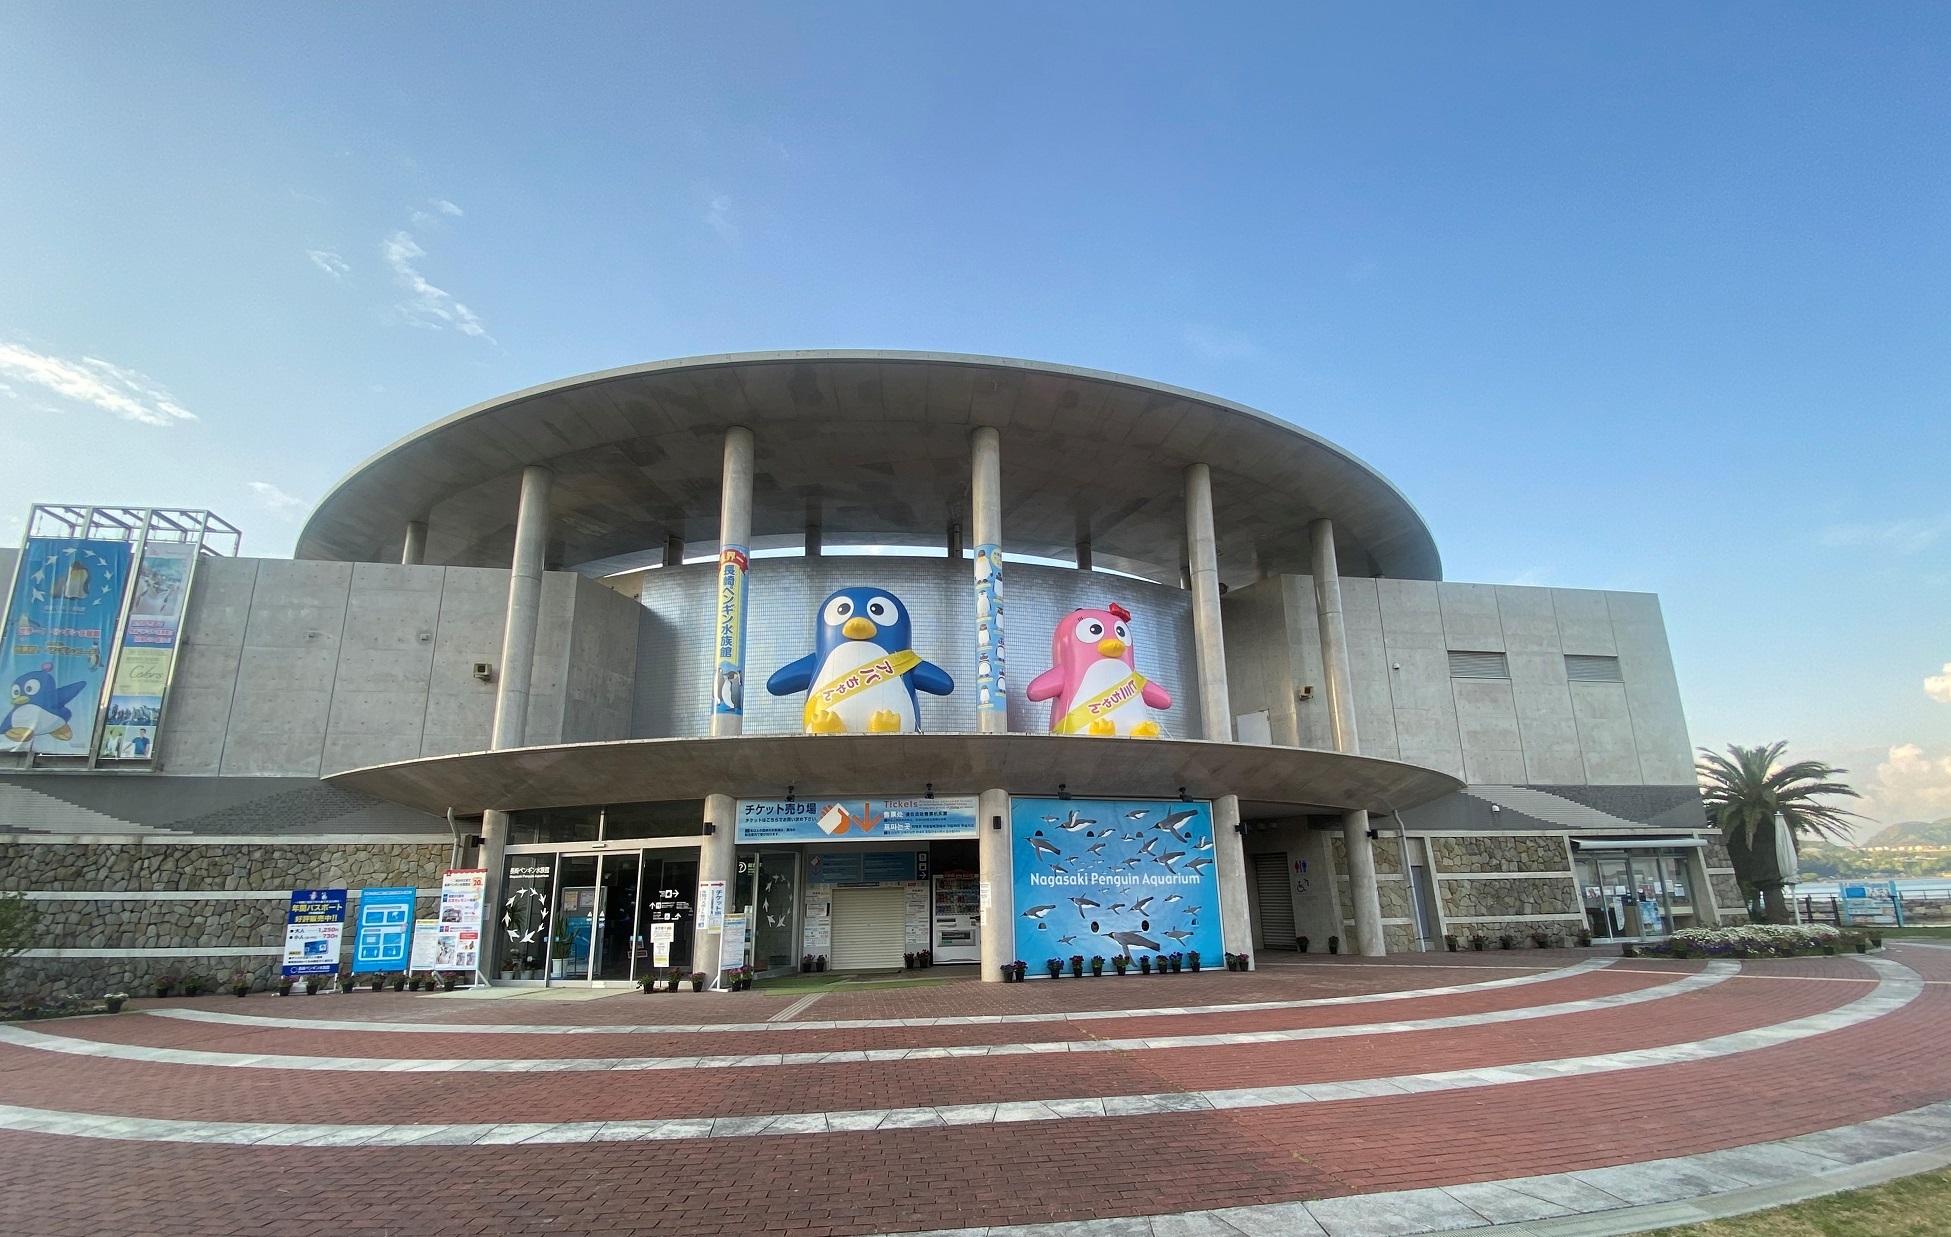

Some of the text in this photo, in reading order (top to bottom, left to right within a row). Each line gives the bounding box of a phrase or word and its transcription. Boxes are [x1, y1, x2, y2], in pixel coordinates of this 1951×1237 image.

[720, 565, 735, 657] 長崎ペンギン水族館
[823, 660, 893, 701] アバちゃん
[745, 803, 817, 815] チケット売り場
[1030, 872, 1200, 887] Nagasaki Penguin Aquarium
[291, 903, 343, 912] 年間パスポート
